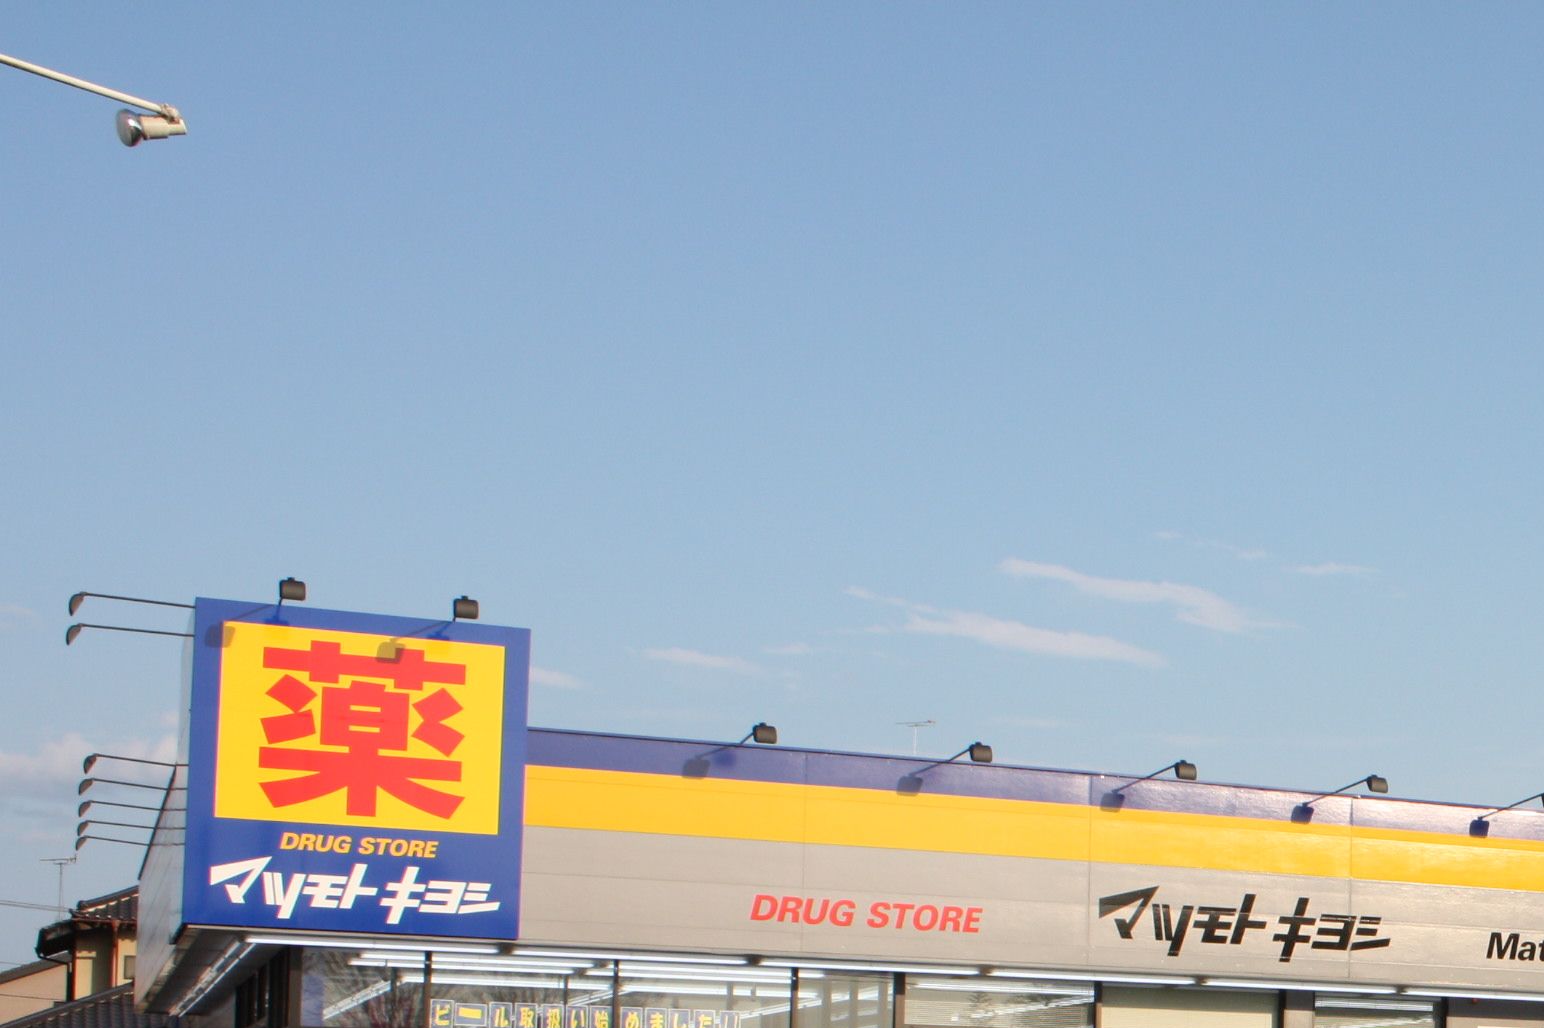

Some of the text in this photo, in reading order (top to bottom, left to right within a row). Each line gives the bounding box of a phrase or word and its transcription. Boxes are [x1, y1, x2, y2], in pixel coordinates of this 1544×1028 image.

[258, 640, 466, 819] 薬
[280, 832, 439, 859] DRUG STORE
[209, 856, 501, 924] マツモトキヨシ
[750, 894, 983, 933] DRUG STORE
[1098, 885, 1391, 962] マツモトキヨシ
